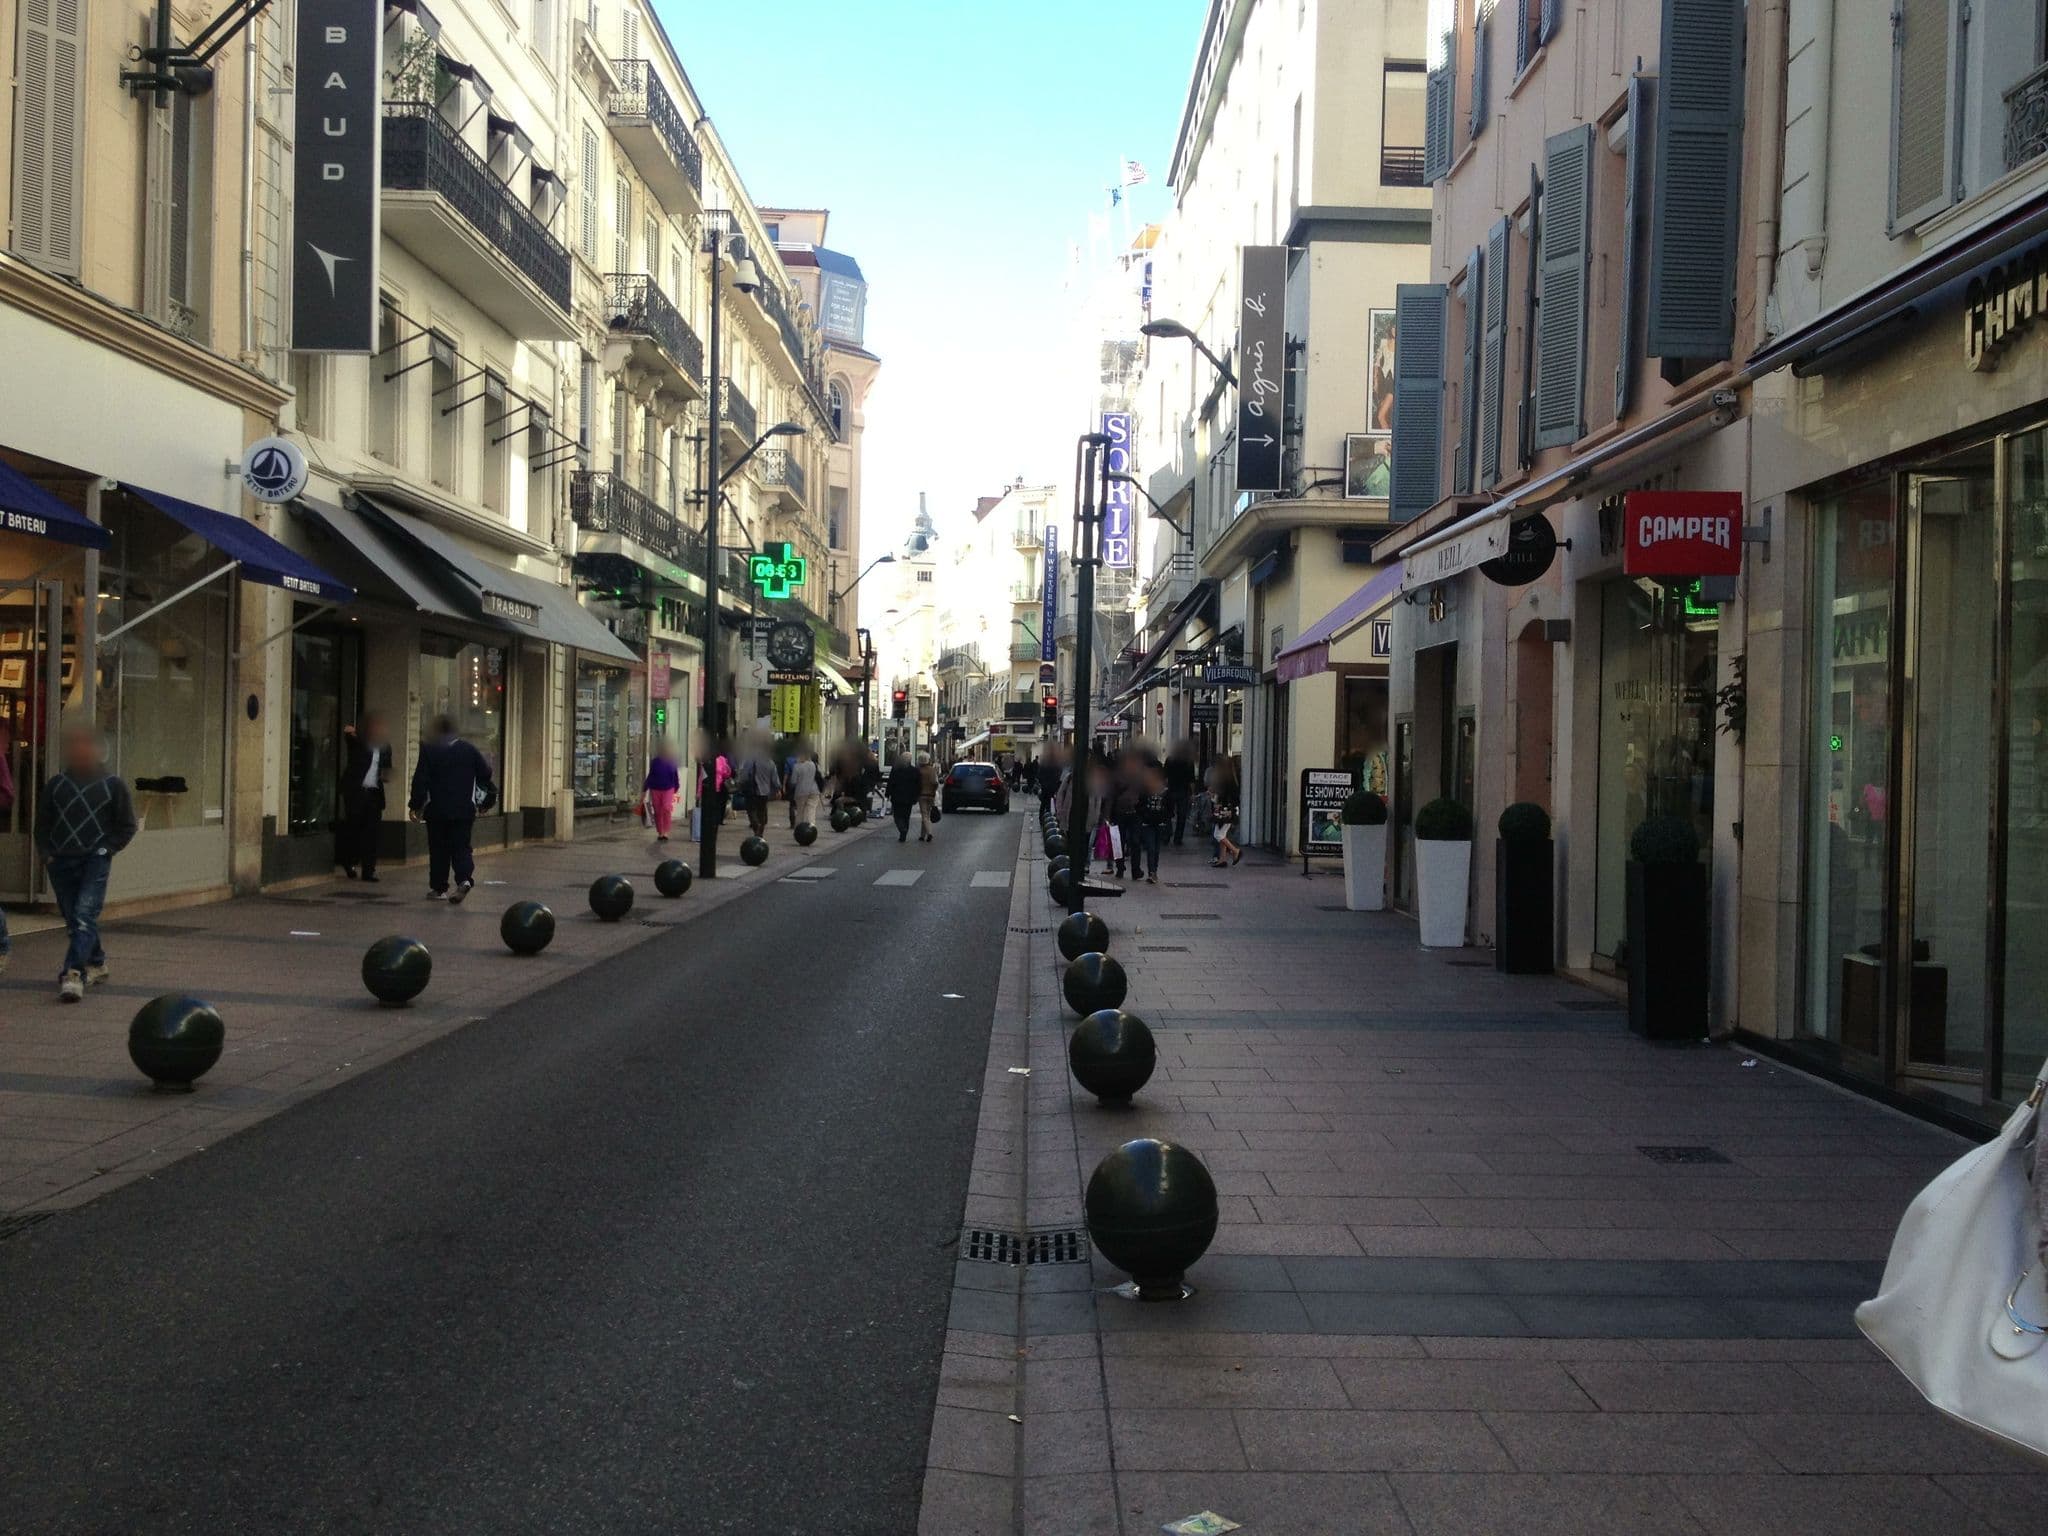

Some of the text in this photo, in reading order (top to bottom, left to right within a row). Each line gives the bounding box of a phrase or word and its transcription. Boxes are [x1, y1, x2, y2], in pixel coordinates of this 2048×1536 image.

[244, 473, 298, 498] PETIT BATEAU
[1104, 417, 1130, 566] SORIE
[8, 512, 47, 535] BATEAU
[1639, 515, 1731, 550] CAMPER
[1438, 543, 1464, 573] WEILL
[283, 575, 321, 594] PETIT BATEAU
[491, 596, 532, 620] TRABAUD
[769, 672, 811, 681] BREITLING
[1205, 667, 1253, 684] VILEBREQUIN
[1305, 785, 1355, 799] LE SHOW ROOM
